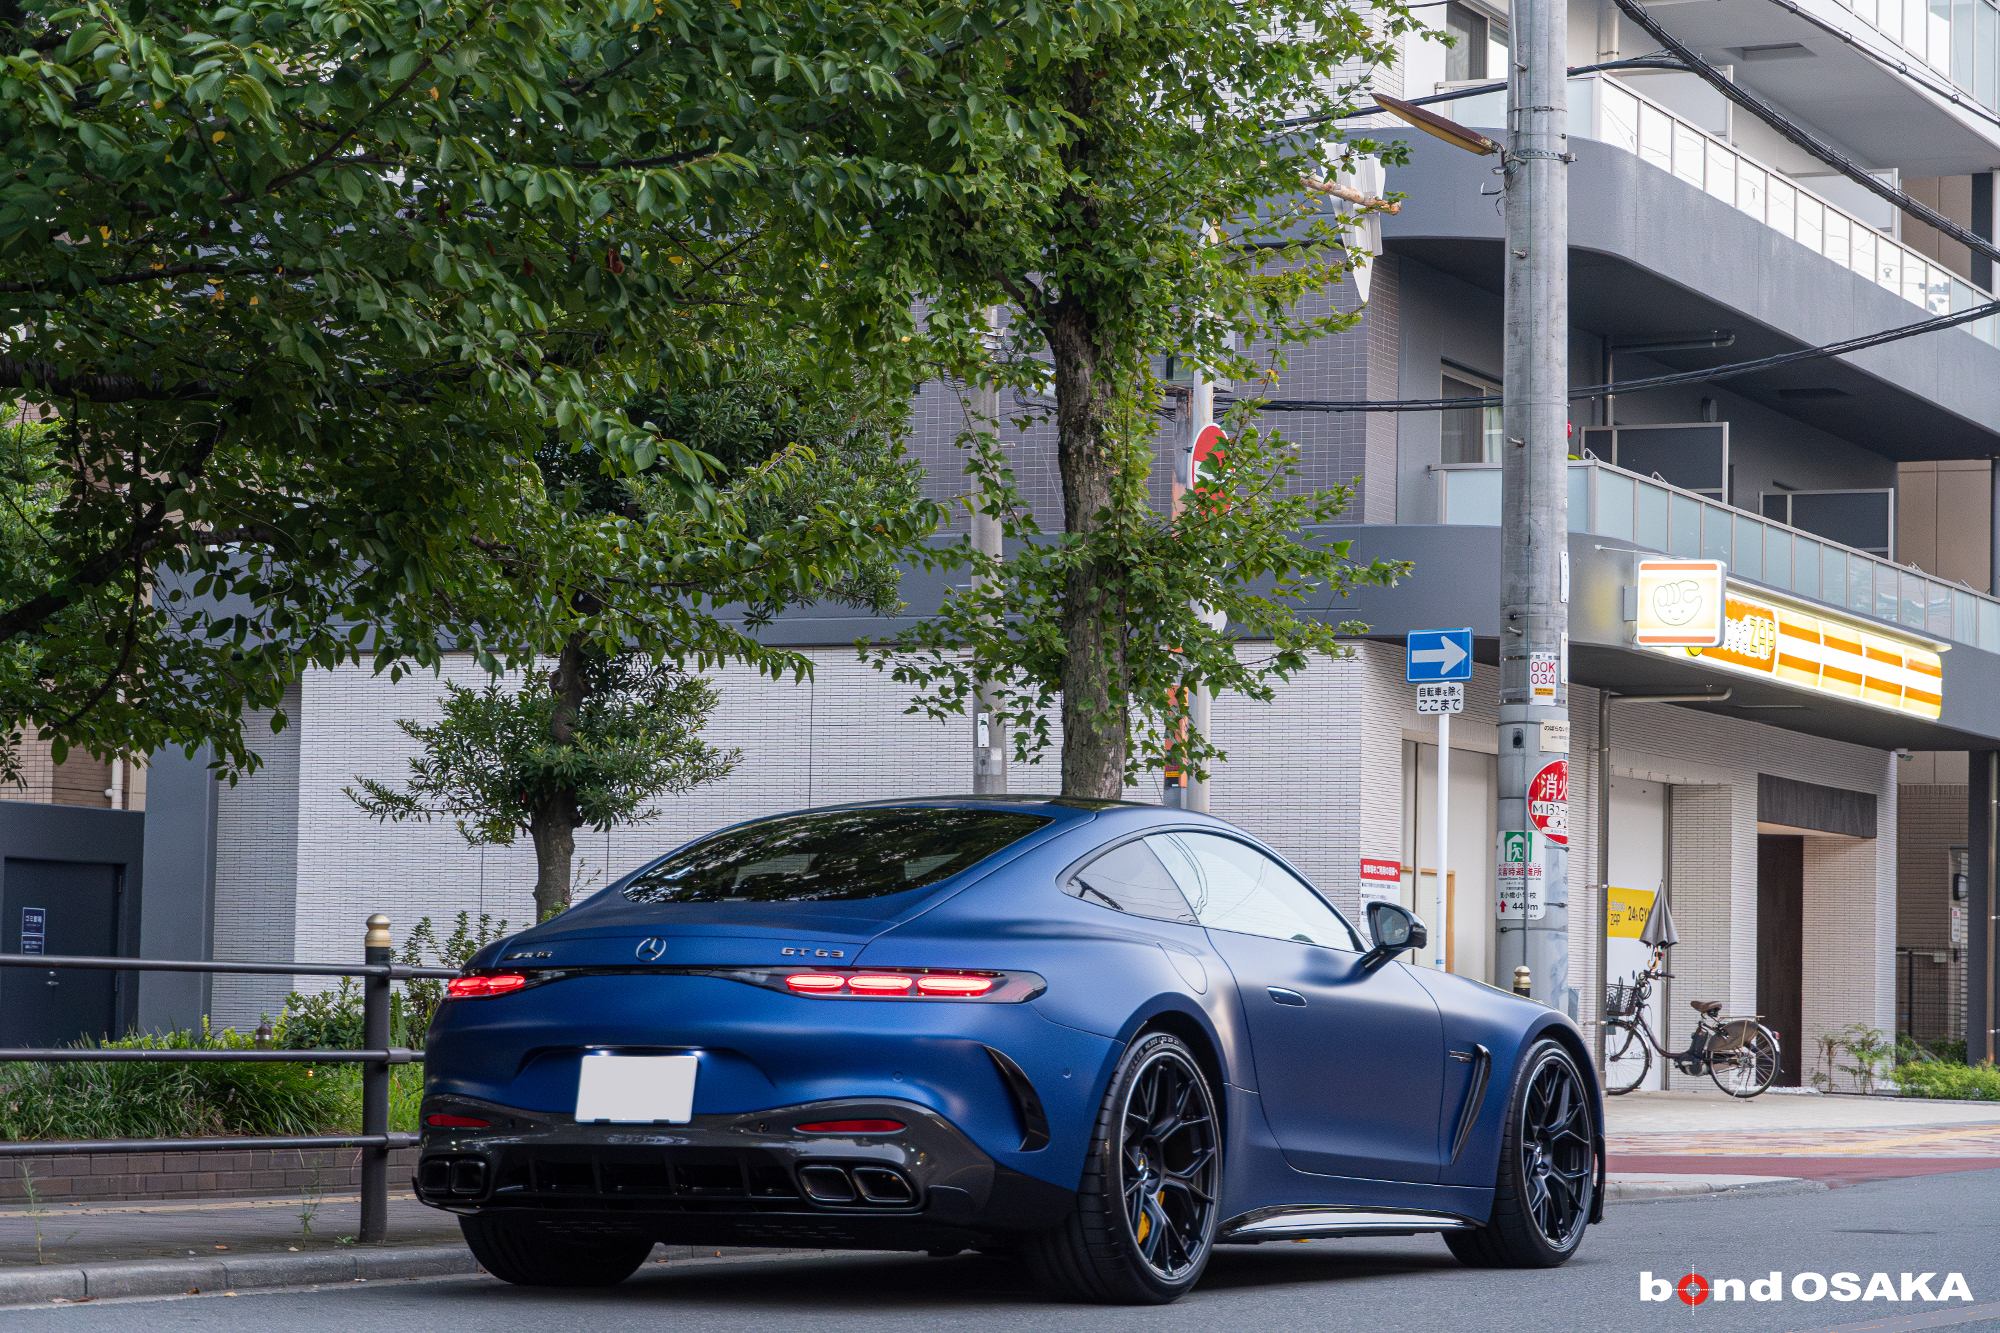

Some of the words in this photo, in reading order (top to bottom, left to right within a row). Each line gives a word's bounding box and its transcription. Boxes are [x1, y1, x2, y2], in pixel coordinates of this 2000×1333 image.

[1419, 686, 1461, 697] 自転車を除く
[1418, 698, 1461, 712] ここまで
[781, 947, 811, 957] GT
[815, 948, 845, 959] 63
